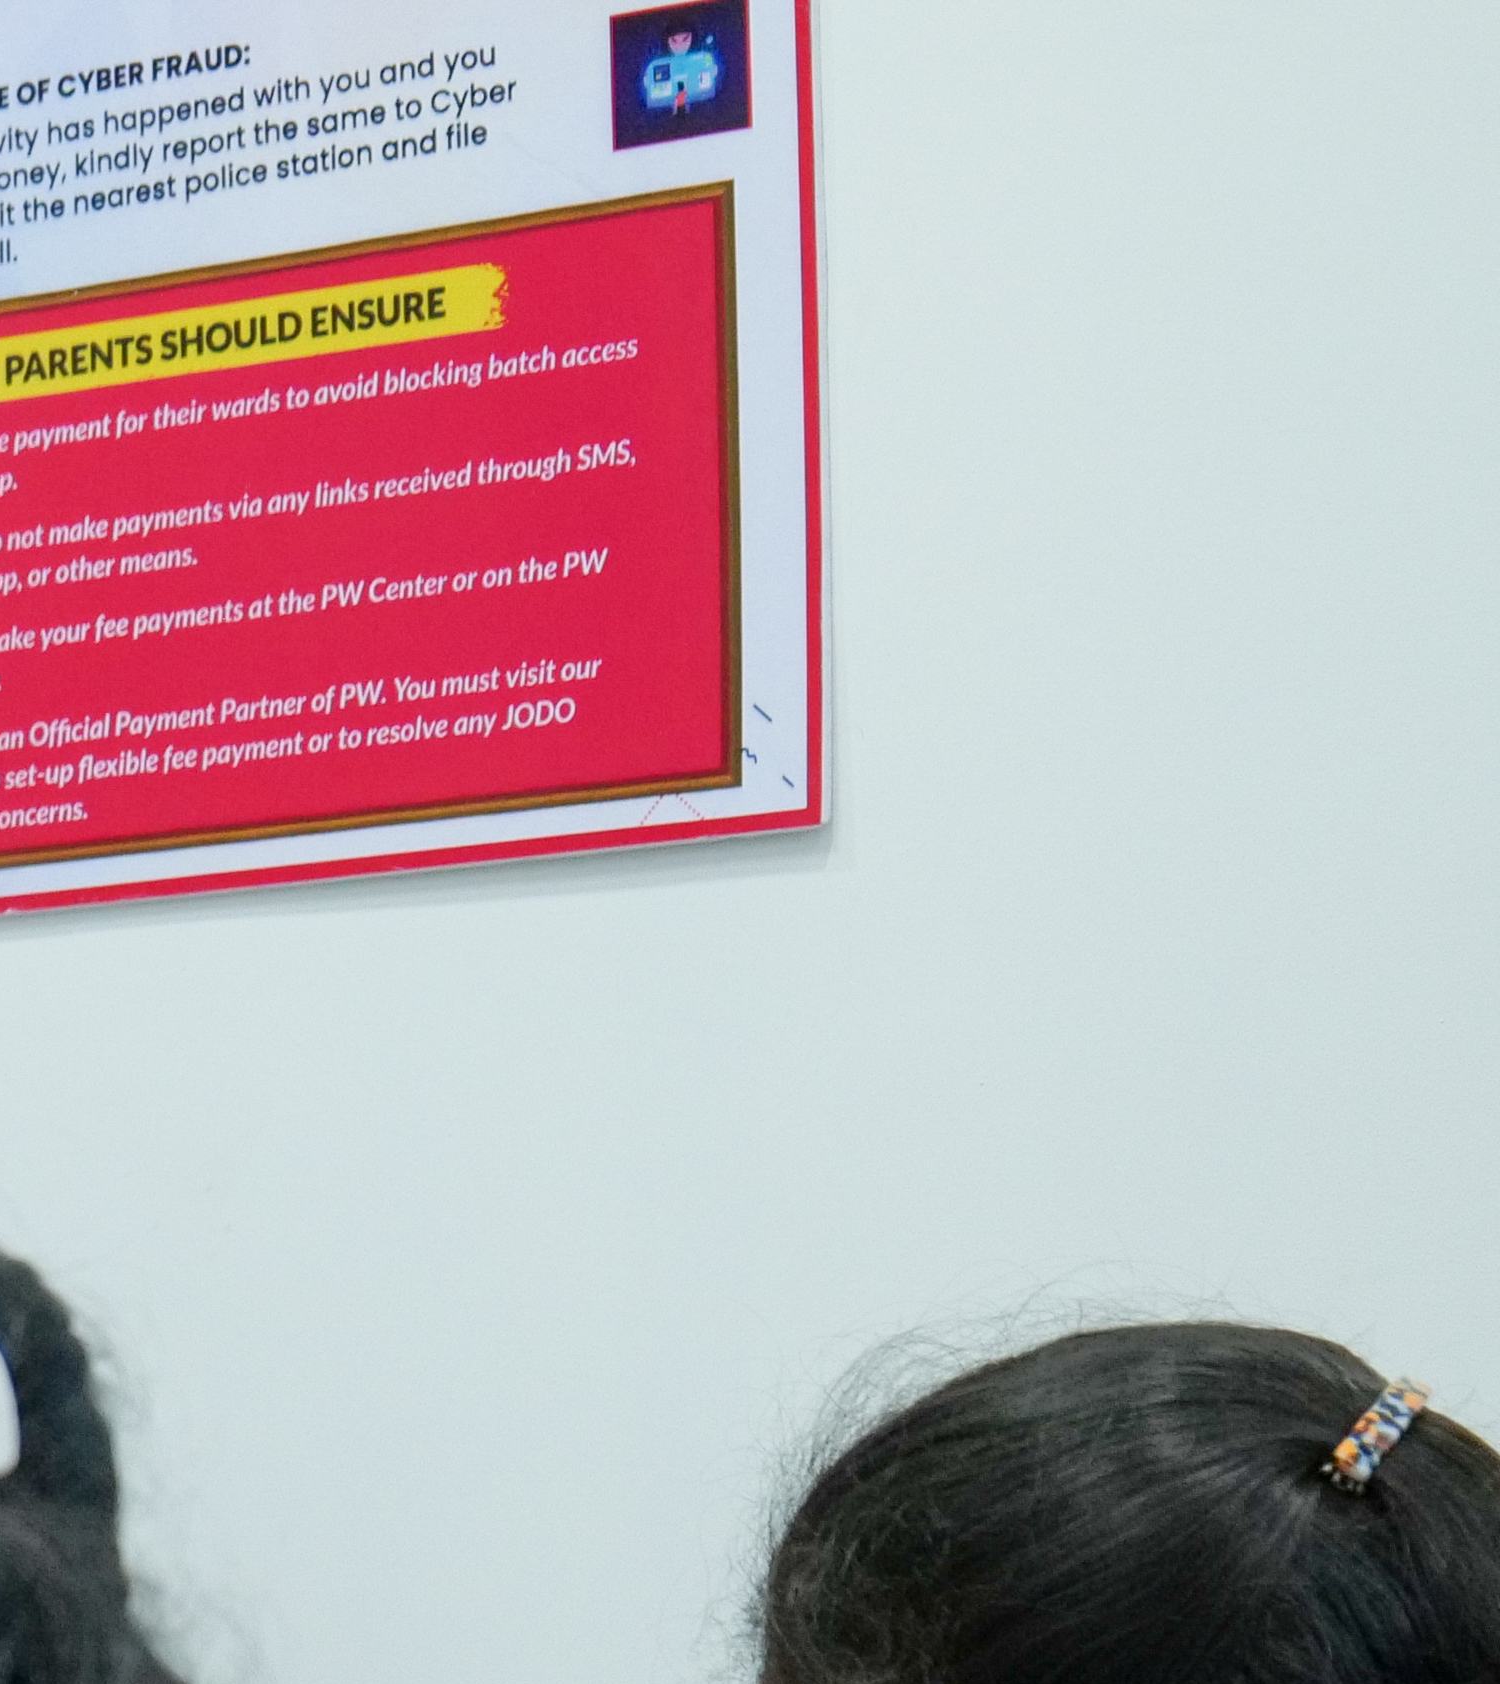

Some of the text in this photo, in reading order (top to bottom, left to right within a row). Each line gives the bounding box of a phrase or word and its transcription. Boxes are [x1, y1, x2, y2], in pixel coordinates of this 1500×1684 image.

[15, 77, 51, 107] OF
[56, 60, 144, 100] CYBER
[151, 43, 251, 83] FRAUD:
[46, 117, 96, 146] has
[103, 85, 245, 138] happened
[252, 74, 311, 109] with
[318, 67, 371, 106] you
[379, 50, 435, 87] and
[443, 44, 496, 83] you
[22, 196, 66, 224] the
[73, 174, 177, 216] nearest
[184, 161, 268, 205] police
[276, 143, 373, 181] station
[381, 127, 438, 163] and
[445, 120, 488, 152] file
[74, 142, 154, 179] kindly
[162, 124, 246, 166] report
[253, 117, 299, 148] the
[306, 103, 387, 139] same
[394, 96, 423, 123] to
[430, 80, 517, 121] Cyber
[4, 285, 447, 387] PARENTS SHOULD ENSURE
[12, 413, 112, 457] payment
[115, 408, 149, 440] for
[152, 398, 208, 432] their
[211, 386, 281, 422] wards
[285, 385, 311, 411] to
[313, 370, 380, 407] avoid
[383, 359, 484, 396] blocking
[487, 344, 557, 381] batch
[560, 337, 639, 370] access
